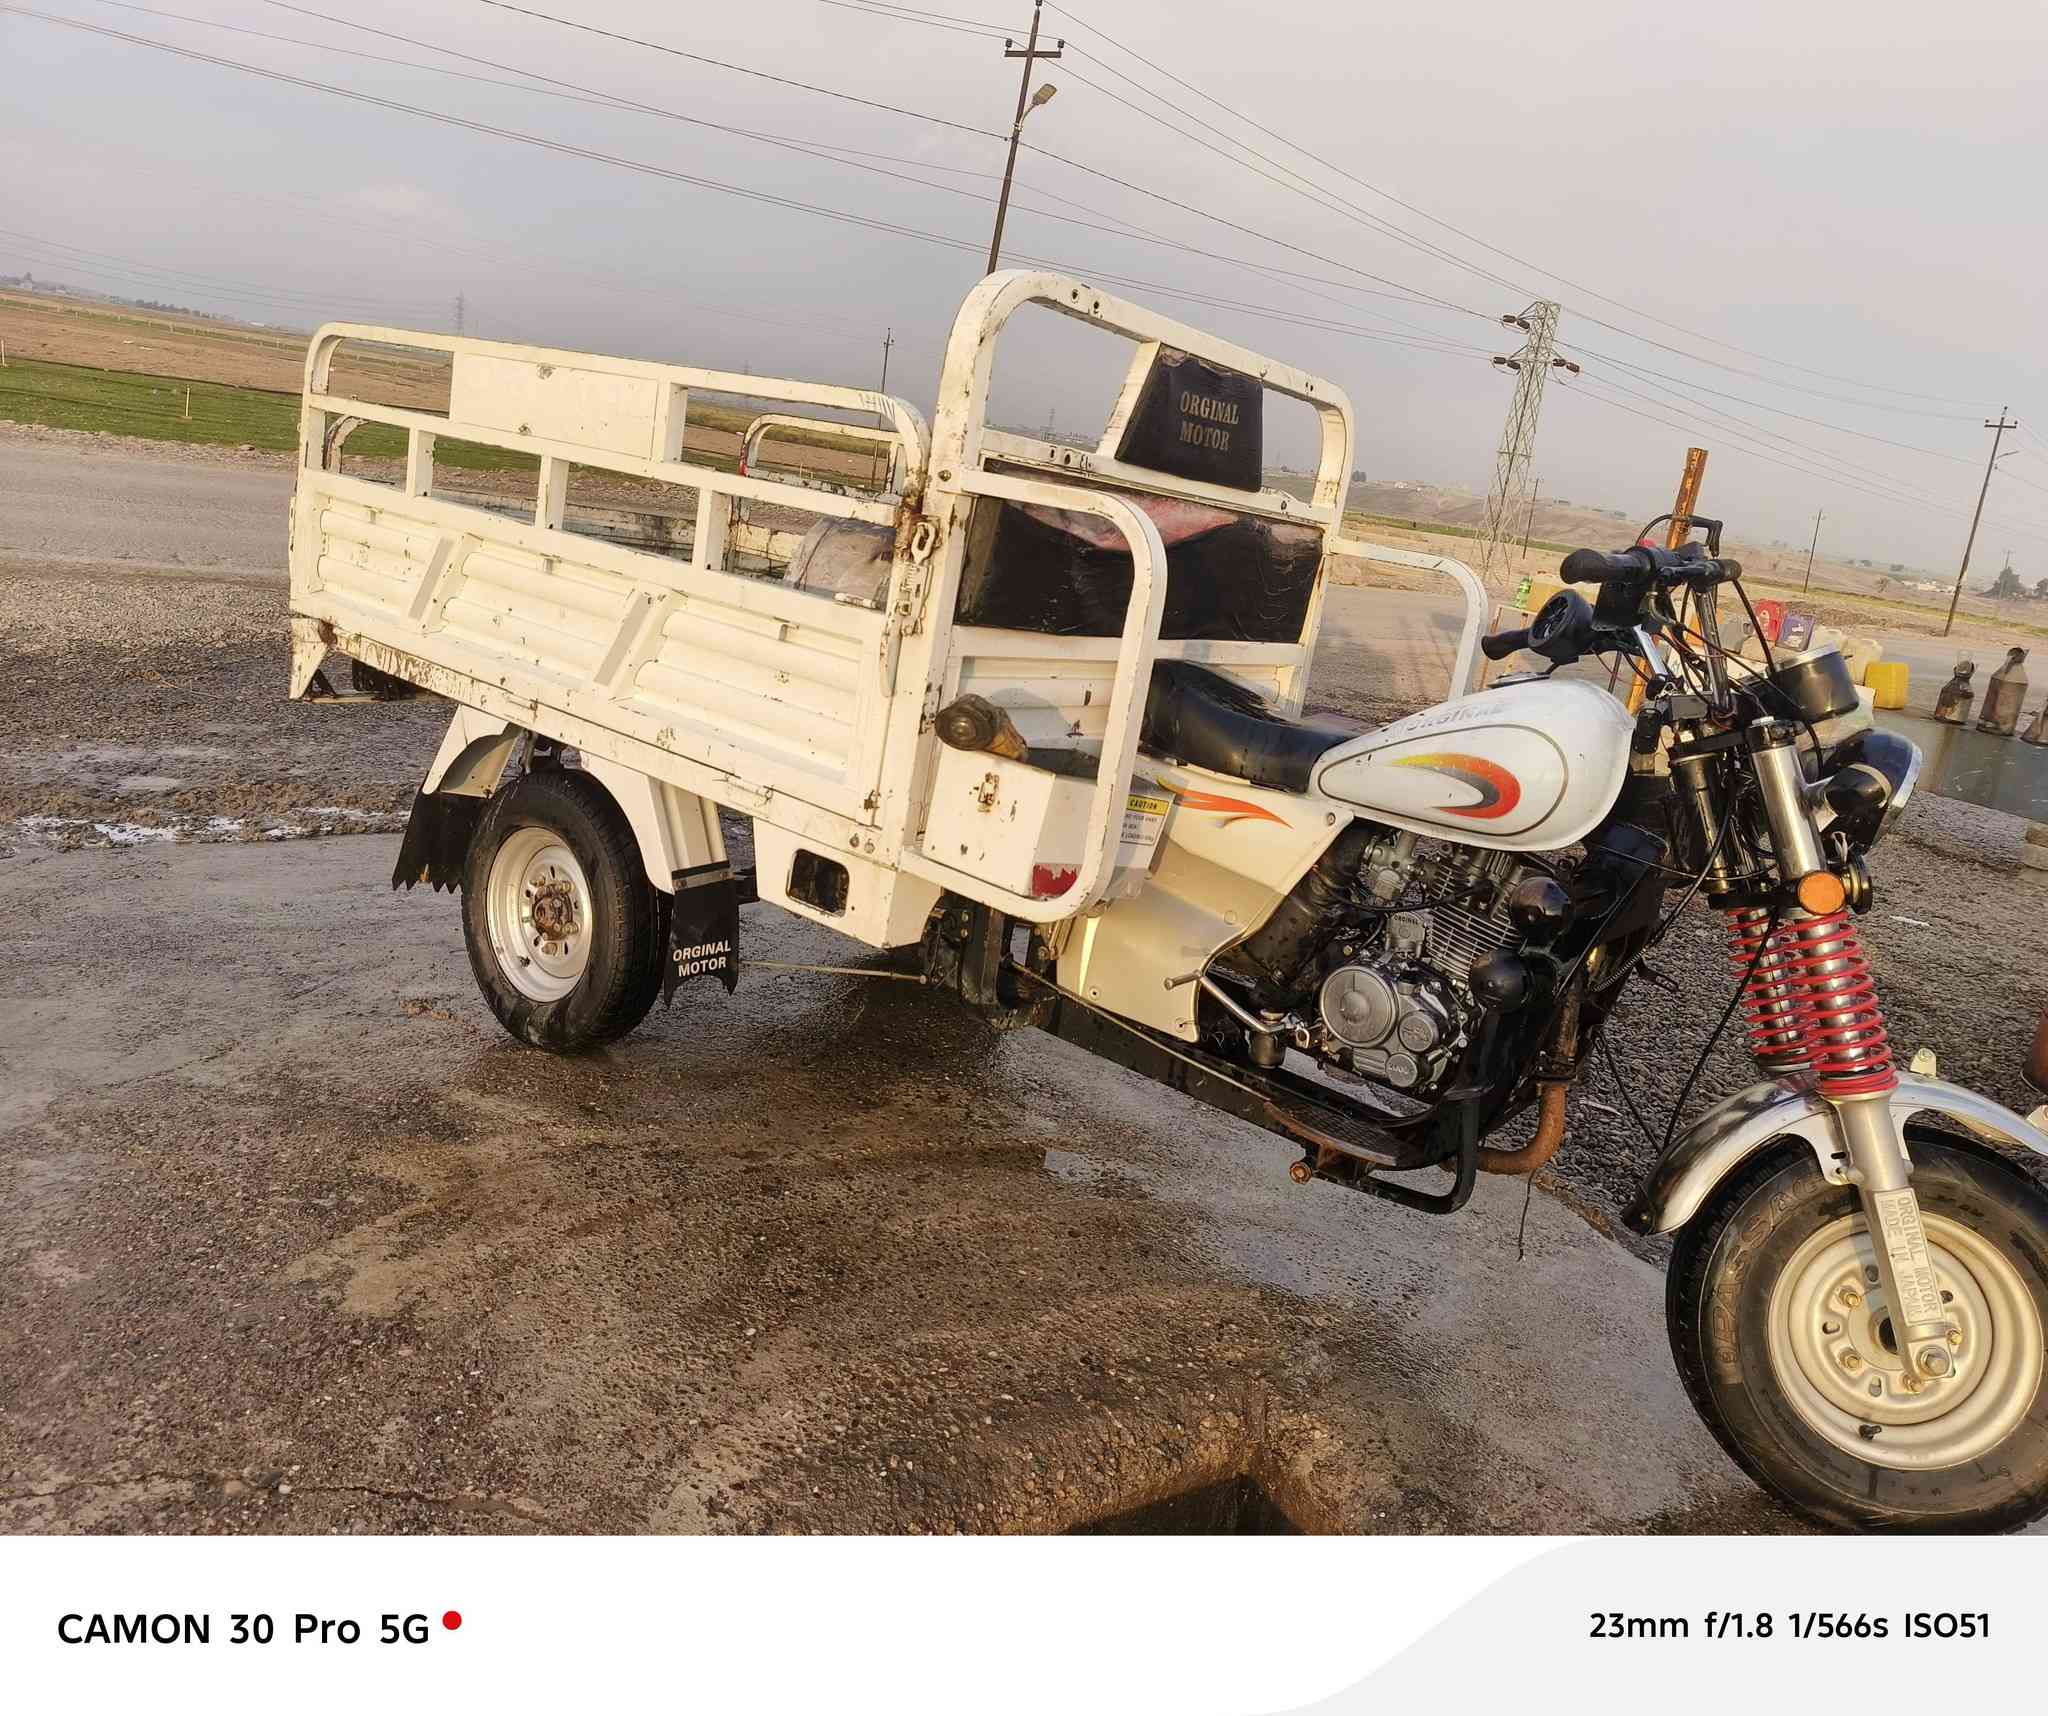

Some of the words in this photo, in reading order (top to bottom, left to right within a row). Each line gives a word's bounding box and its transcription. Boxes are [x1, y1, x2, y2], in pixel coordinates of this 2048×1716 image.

[1180, 391, 1240, 425] ORGINAL
[1179, 420, 1230, 451] MOTOR
[672, 939, 731, 962] ORGINAL
[678, 956, 727, 977] MOTOR
